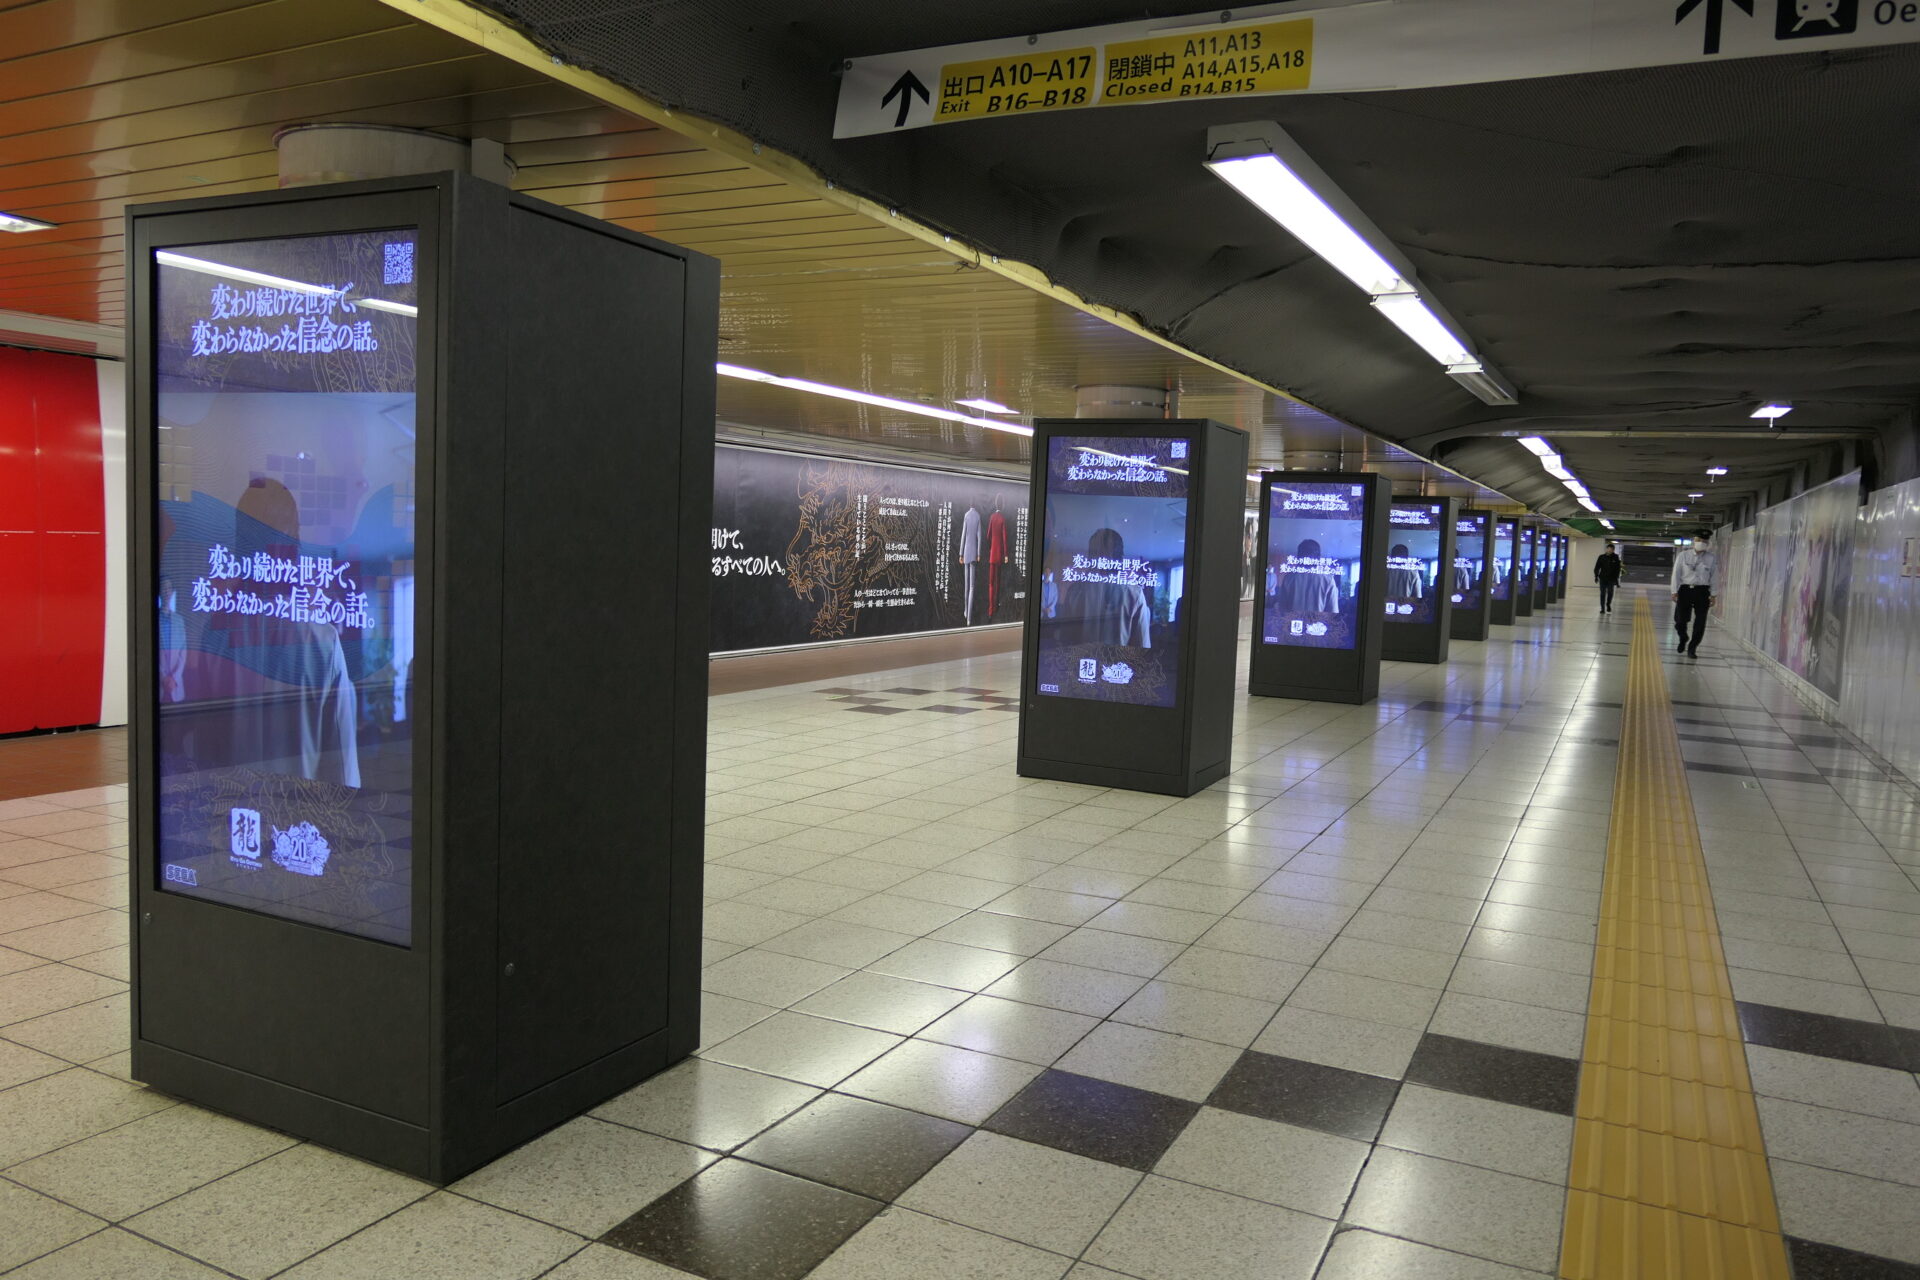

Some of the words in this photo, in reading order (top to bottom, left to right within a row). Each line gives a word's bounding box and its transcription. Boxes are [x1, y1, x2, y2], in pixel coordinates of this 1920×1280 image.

[1183, 31, 1262, 58] A11,A13
[1108, 52, 1175, 81] 閉鎖中
[1182, 50, 1305, 80] A14,A15,A18
[944, 76, 984, 98] 出口
[1105, 78, 1173, 97] Closed
[1180, 78, 1256, 97] B14,B15
[941, 99, 971, 114] Exit
[211, 282, 356, 320] 変わり続けた世界で、
[192, 315, 378, 356] 変わらなかった信念の話。
[208, 543, 356, 590] 変わり続けた世界で、
[712, 556, 786, 577] るすべての人へ。
[192, 577, 375, 629] 変わらなかった信念の話。
[291, 837, 307, 862] 20
[166, 864, 198, 886] SEGA
